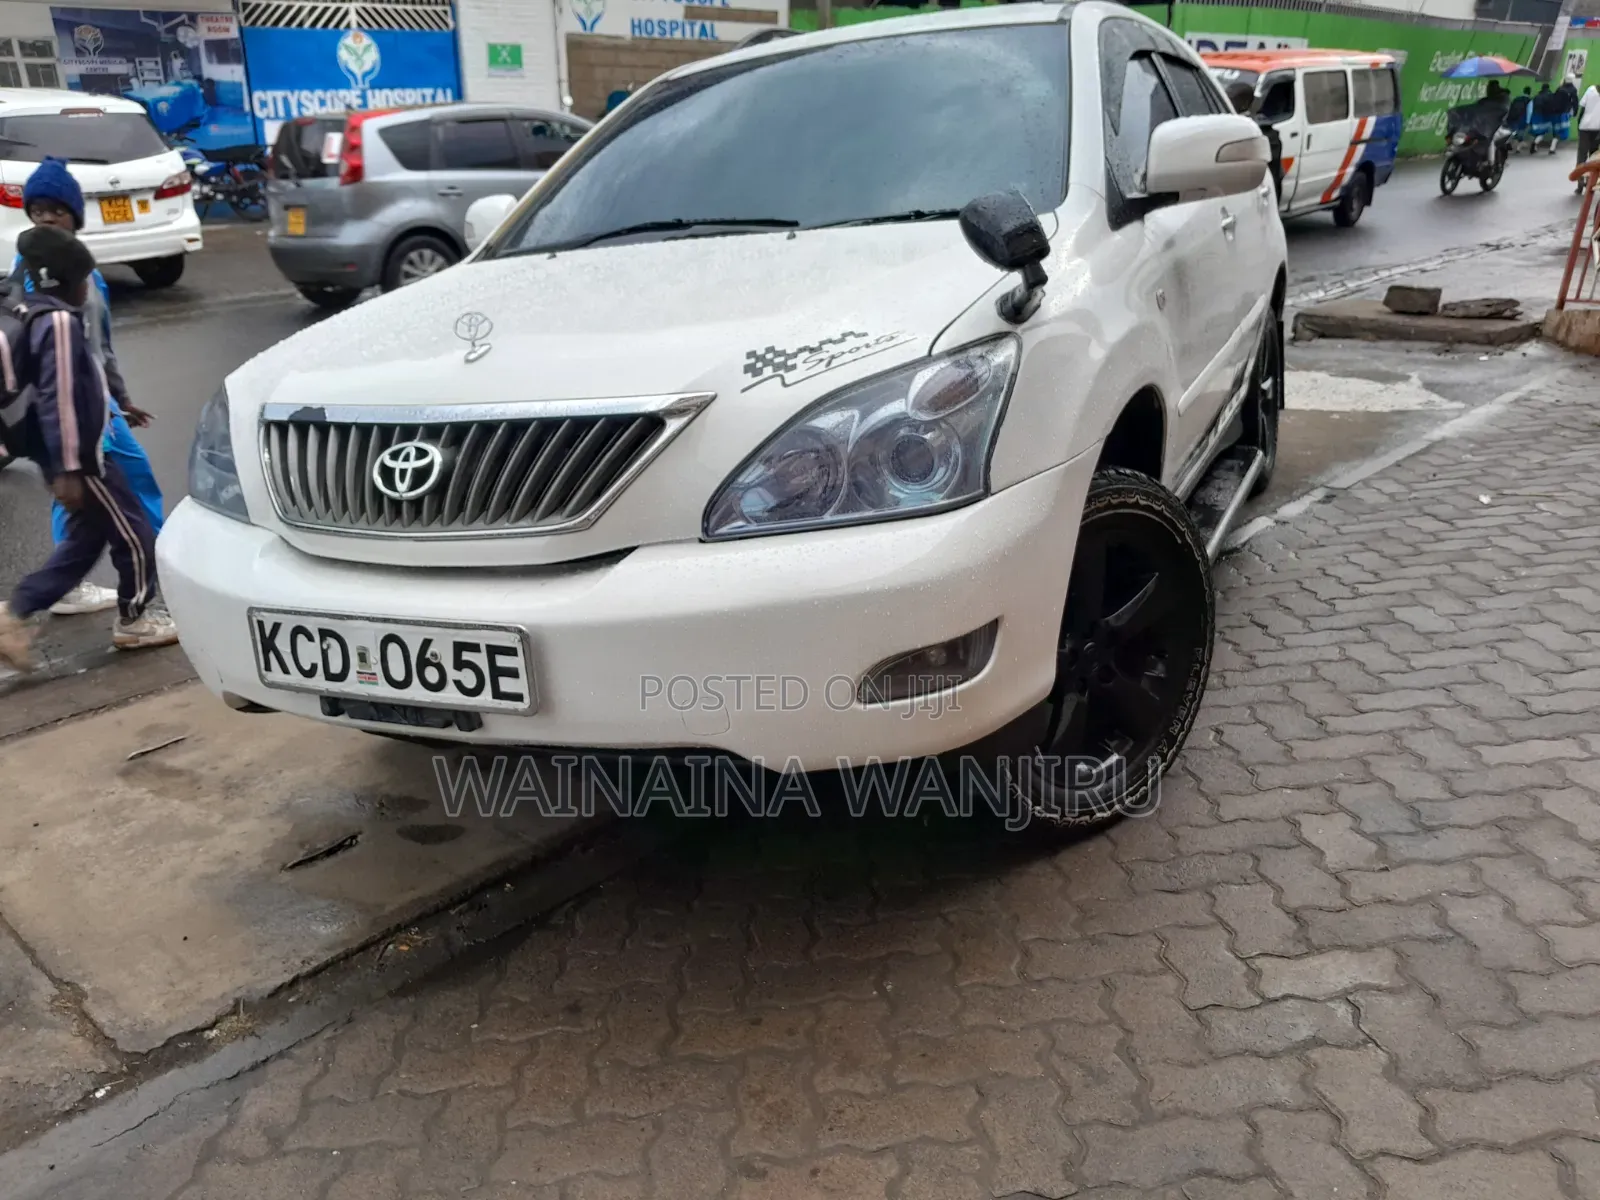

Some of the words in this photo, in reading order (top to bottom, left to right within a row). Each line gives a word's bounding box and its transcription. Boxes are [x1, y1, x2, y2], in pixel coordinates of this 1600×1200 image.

[630, 17, 718, 40] HOSPITAL
[251, 88, 363, 119] CITYSCOPE
[256, 619, 351, 683] KCD
[379, 633, 524, 702] 065E
